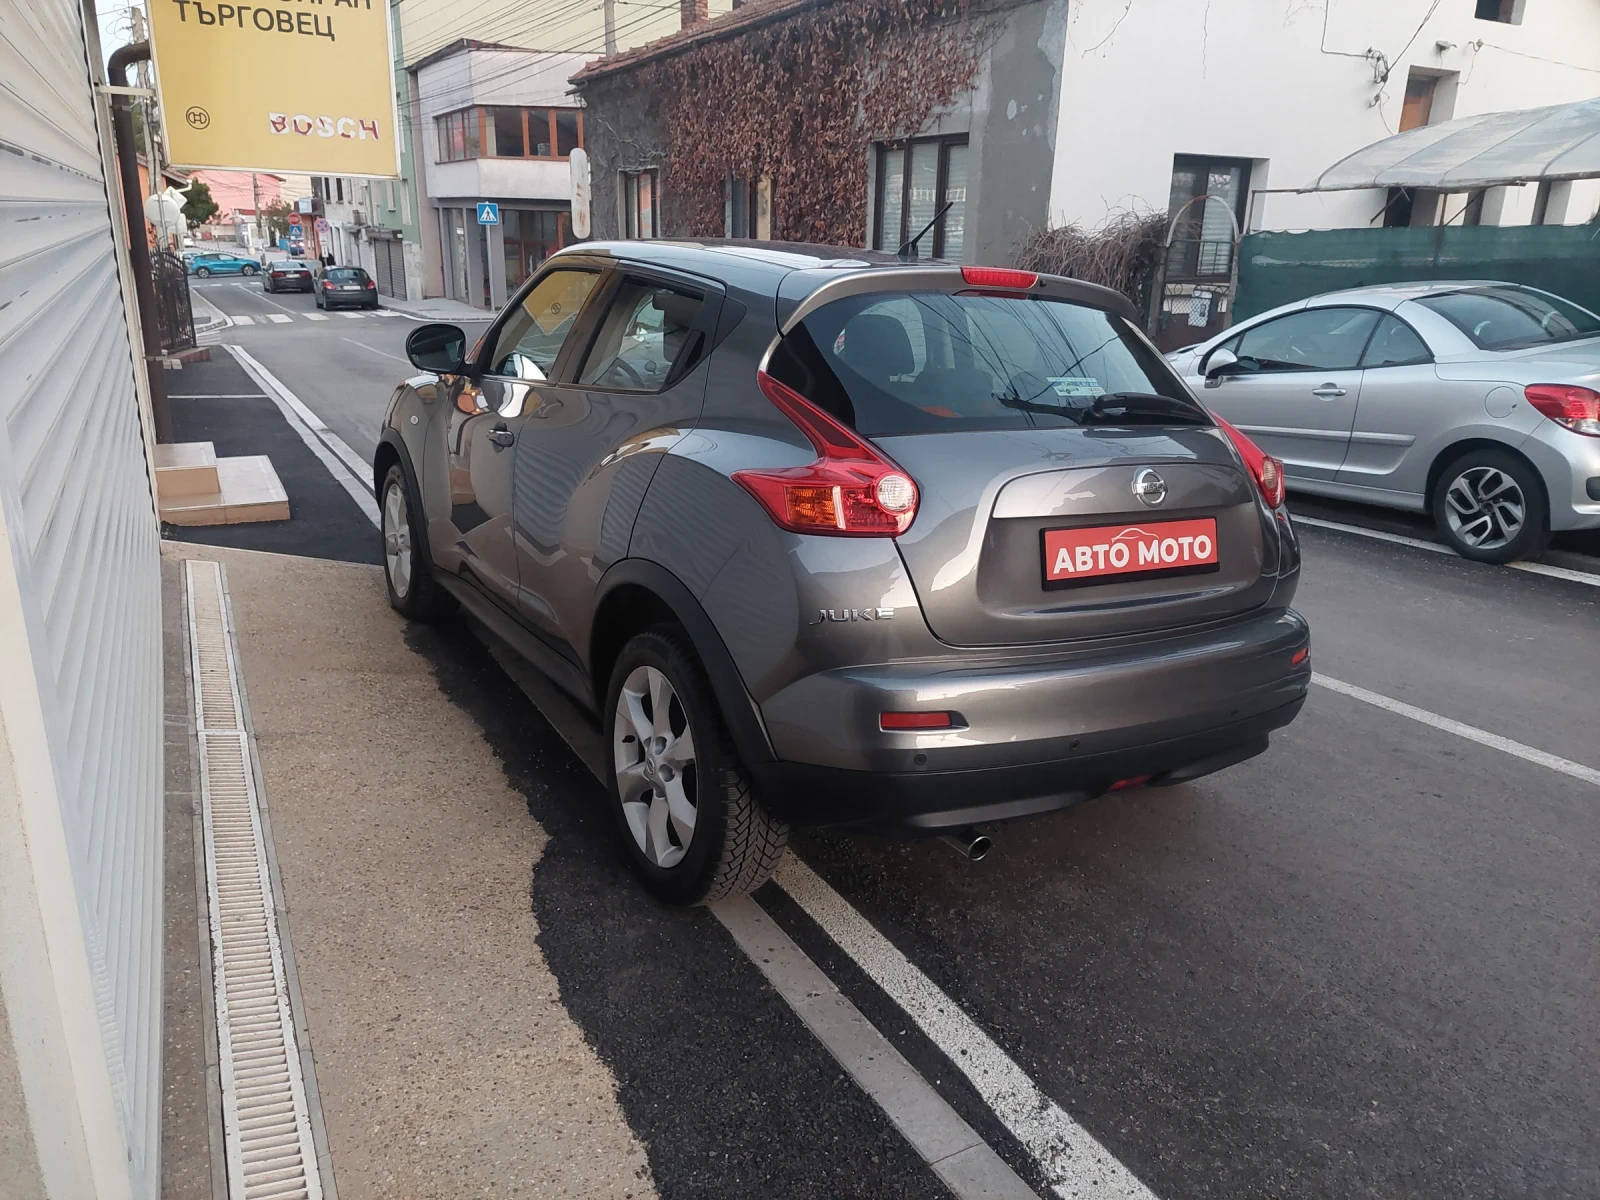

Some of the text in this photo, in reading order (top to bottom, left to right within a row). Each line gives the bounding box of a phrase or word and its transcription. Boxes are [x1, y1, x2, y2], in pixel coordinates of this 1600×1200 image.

[172, 0, 335, 42] ТЪРГОВЕЦ
[269, 112, 379, 141] BOSCH
[1053, 535, 1212, 574] АВТО МОТО
[808, 607, 895, 625] JUKE
